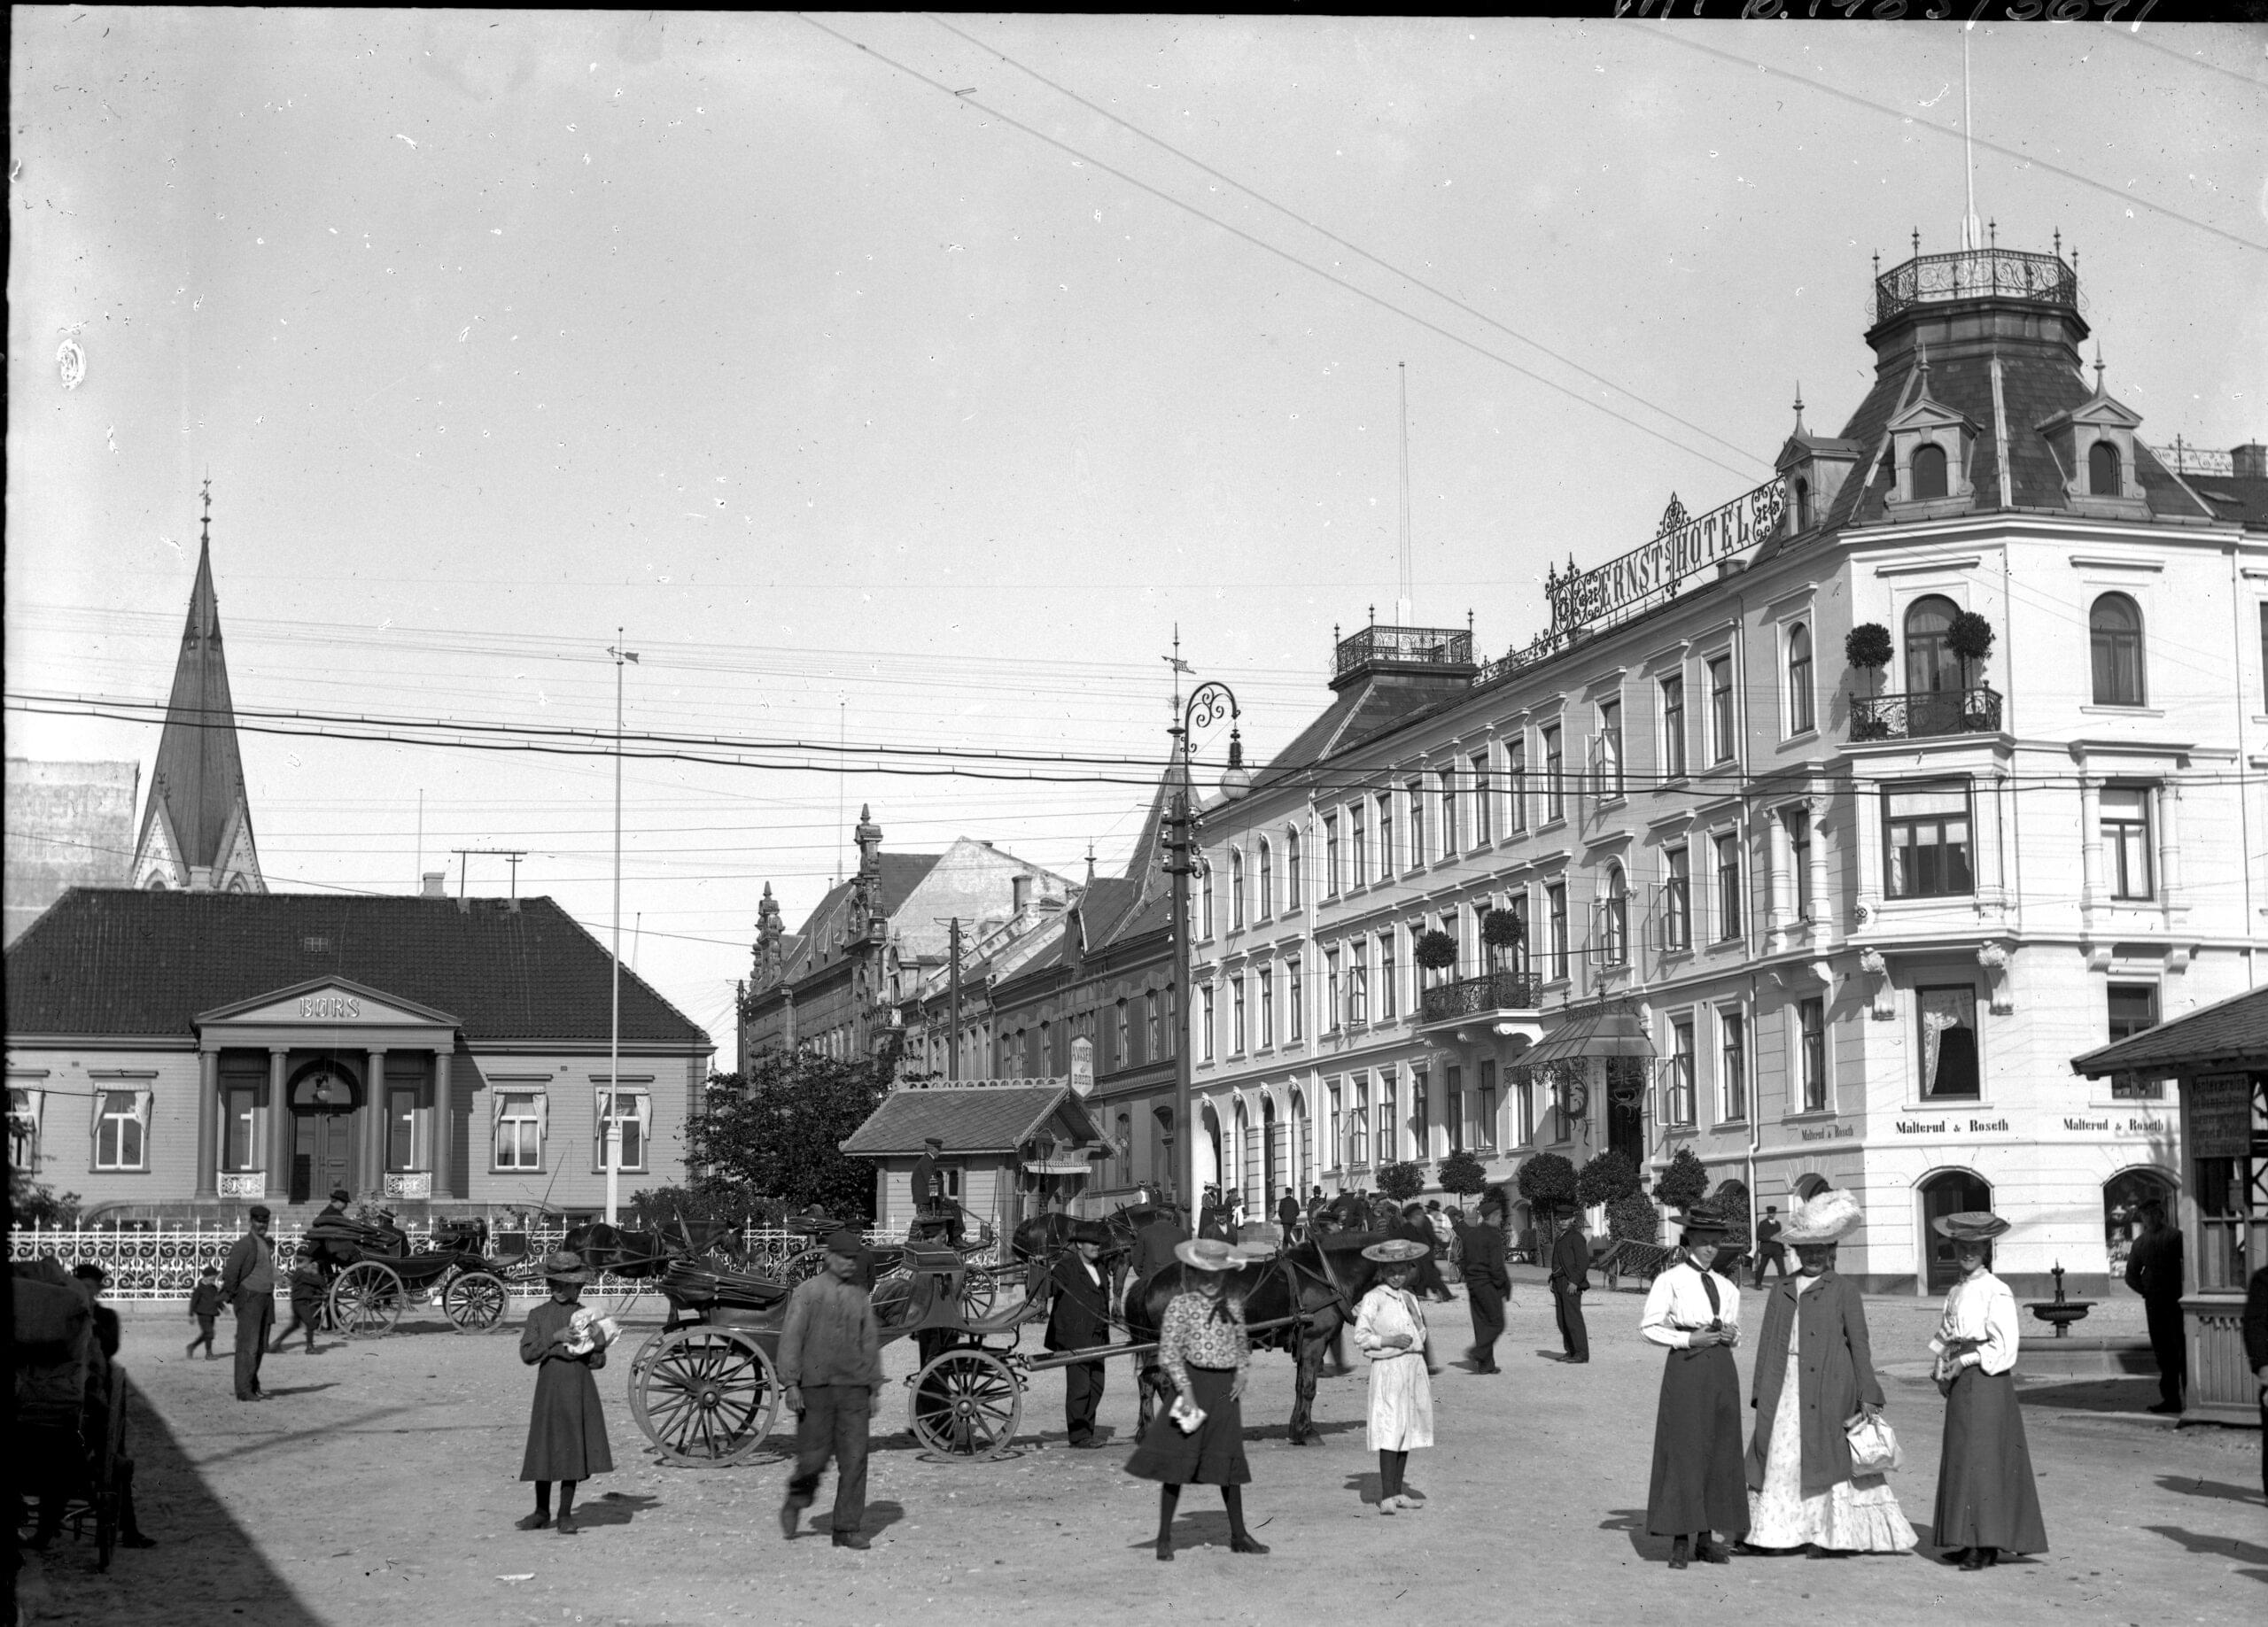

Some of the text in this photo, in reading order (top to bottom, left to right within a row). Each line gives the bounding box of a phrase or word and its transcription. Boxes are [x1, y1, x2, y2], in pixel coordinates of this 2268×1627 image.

[1675, 505, 1750, 573] HOTEL
[299, 997, 361, 1018] BØRS
[1072, 1046, 1092, 1063] AVISER
[1801, 1127, 1825, 1142] Malterud
[1835, 1124, 1854, 1138] Roseth
[1896, 1119, 2009, 1135] Malterud & Roseth
[2063, 1118, 2163, 1131] Malterud & Roseth
